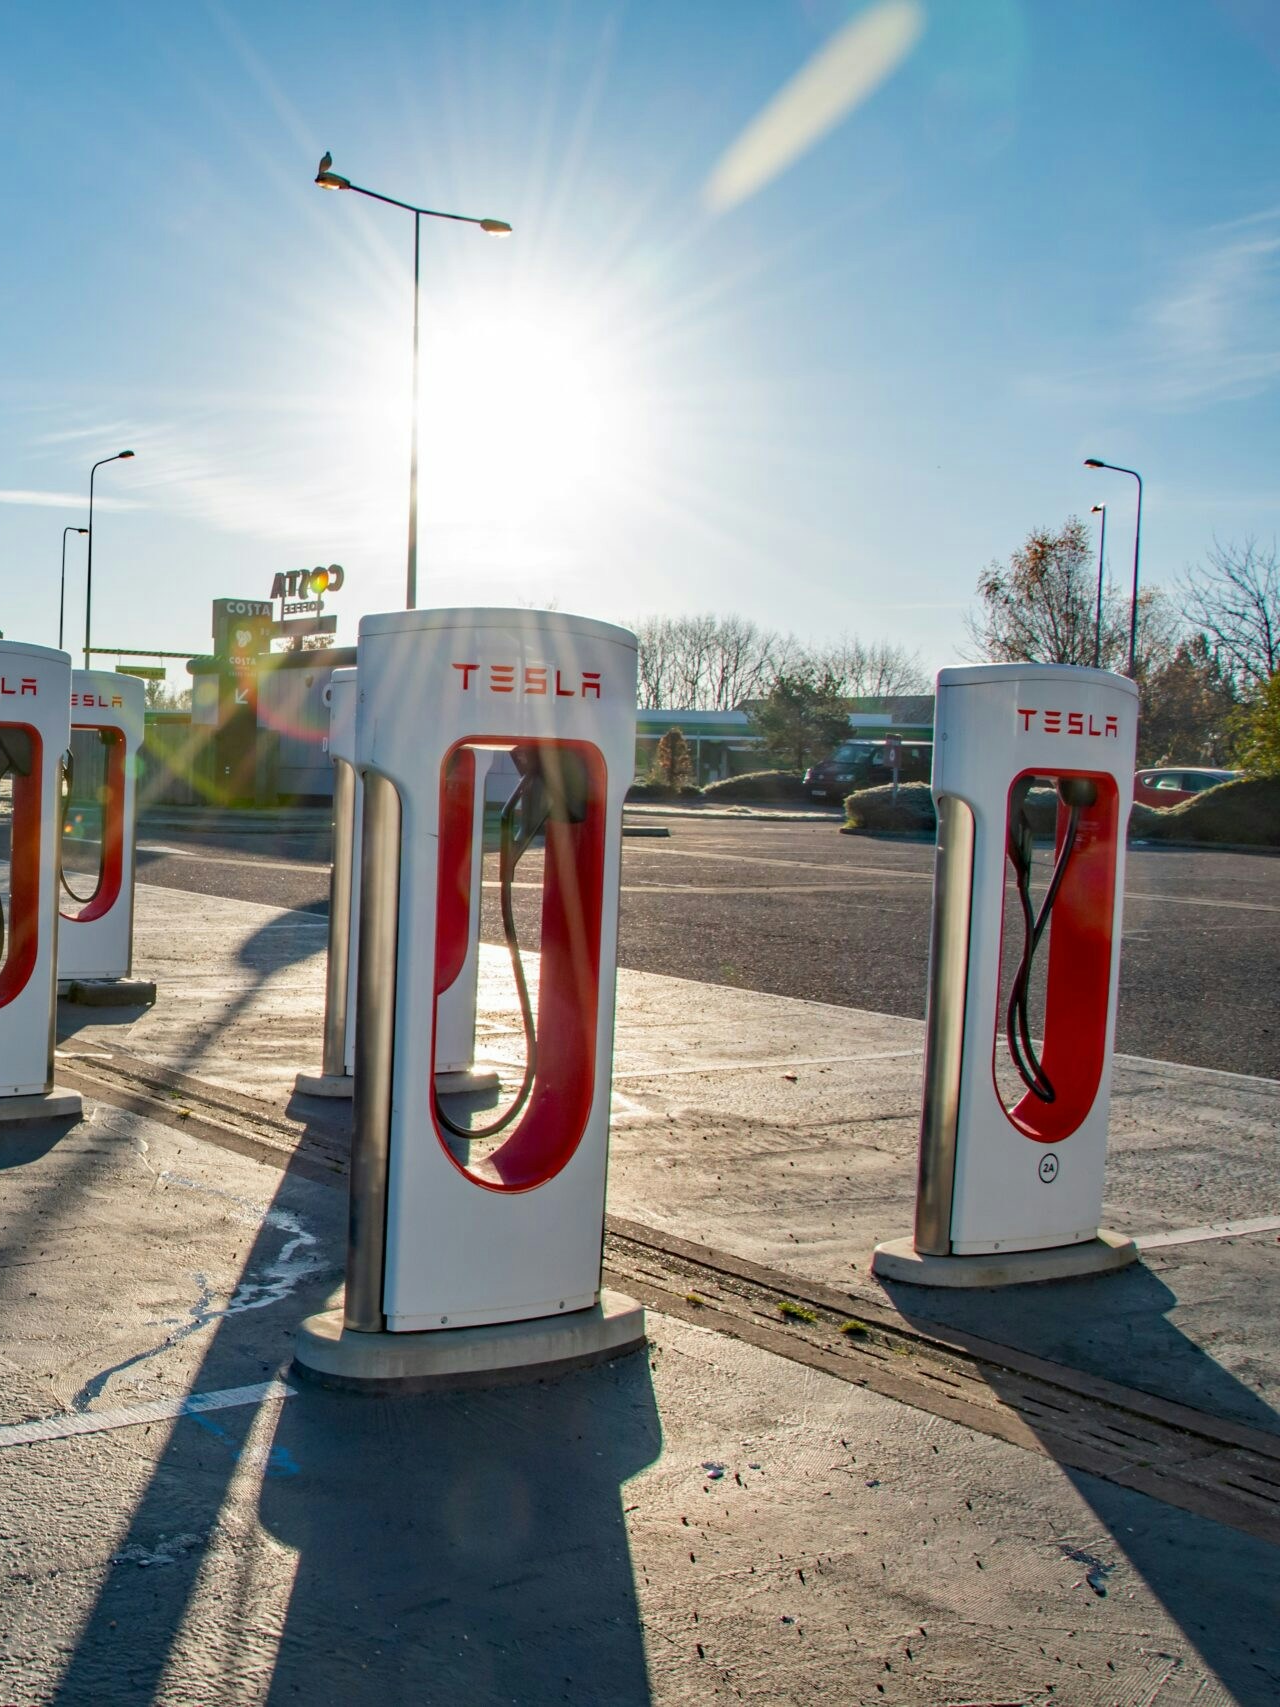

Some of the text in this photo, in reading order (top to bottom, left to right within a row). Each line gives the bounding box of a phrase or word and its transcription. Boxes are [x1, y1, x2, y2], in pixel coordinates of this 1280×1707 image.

[226, 601, 271, 616] COSTA
[229, 656, 257, 666] COSTA
[452, 663, 600, 698] TESLA
[71, 694, 123, 708] ESLA
[1017, 709, 1118, 738] TESLA
[1043, 1164, 1054, 1172] 2A
